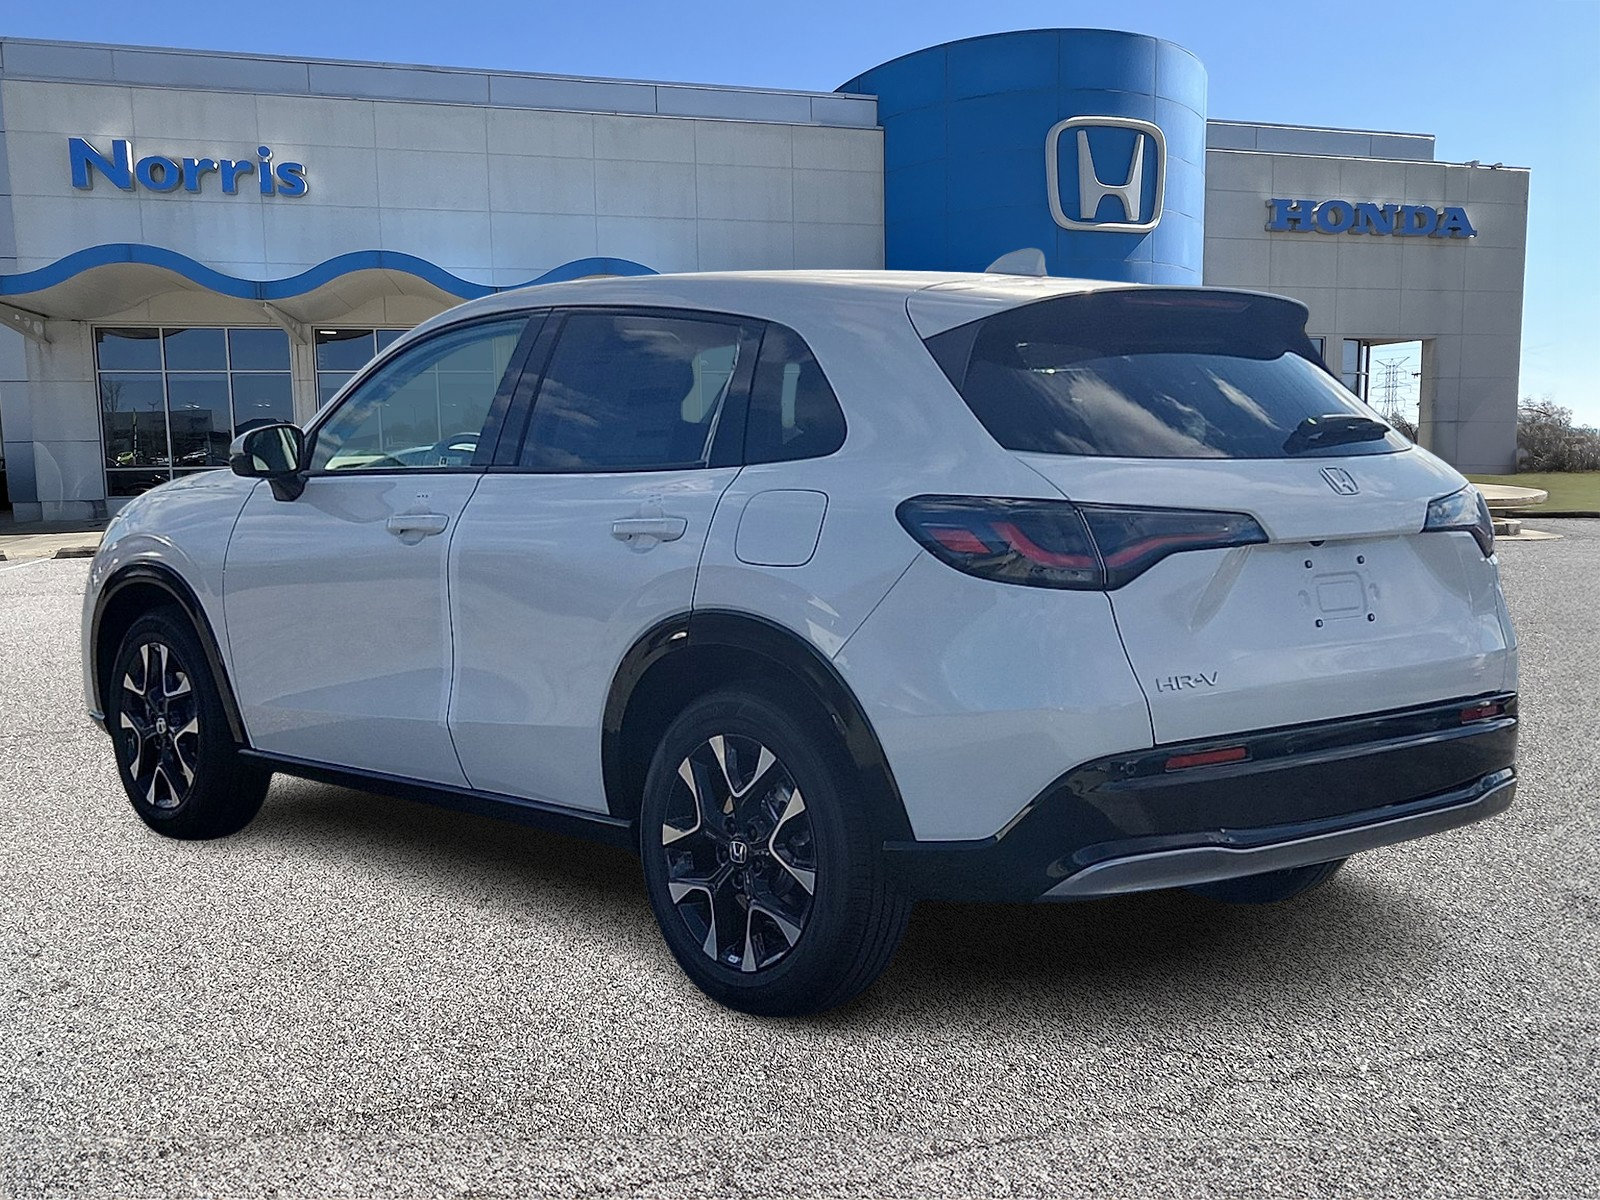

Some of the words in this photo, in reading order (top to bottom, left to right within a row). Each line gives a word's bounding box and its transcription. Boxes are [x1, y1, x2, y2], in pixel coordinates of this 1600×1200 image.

[68, 137, 309, 198] Norris
[1265, 198, 1478, 239] HONDA
[1155, 671, 1218, 692] HR-V
